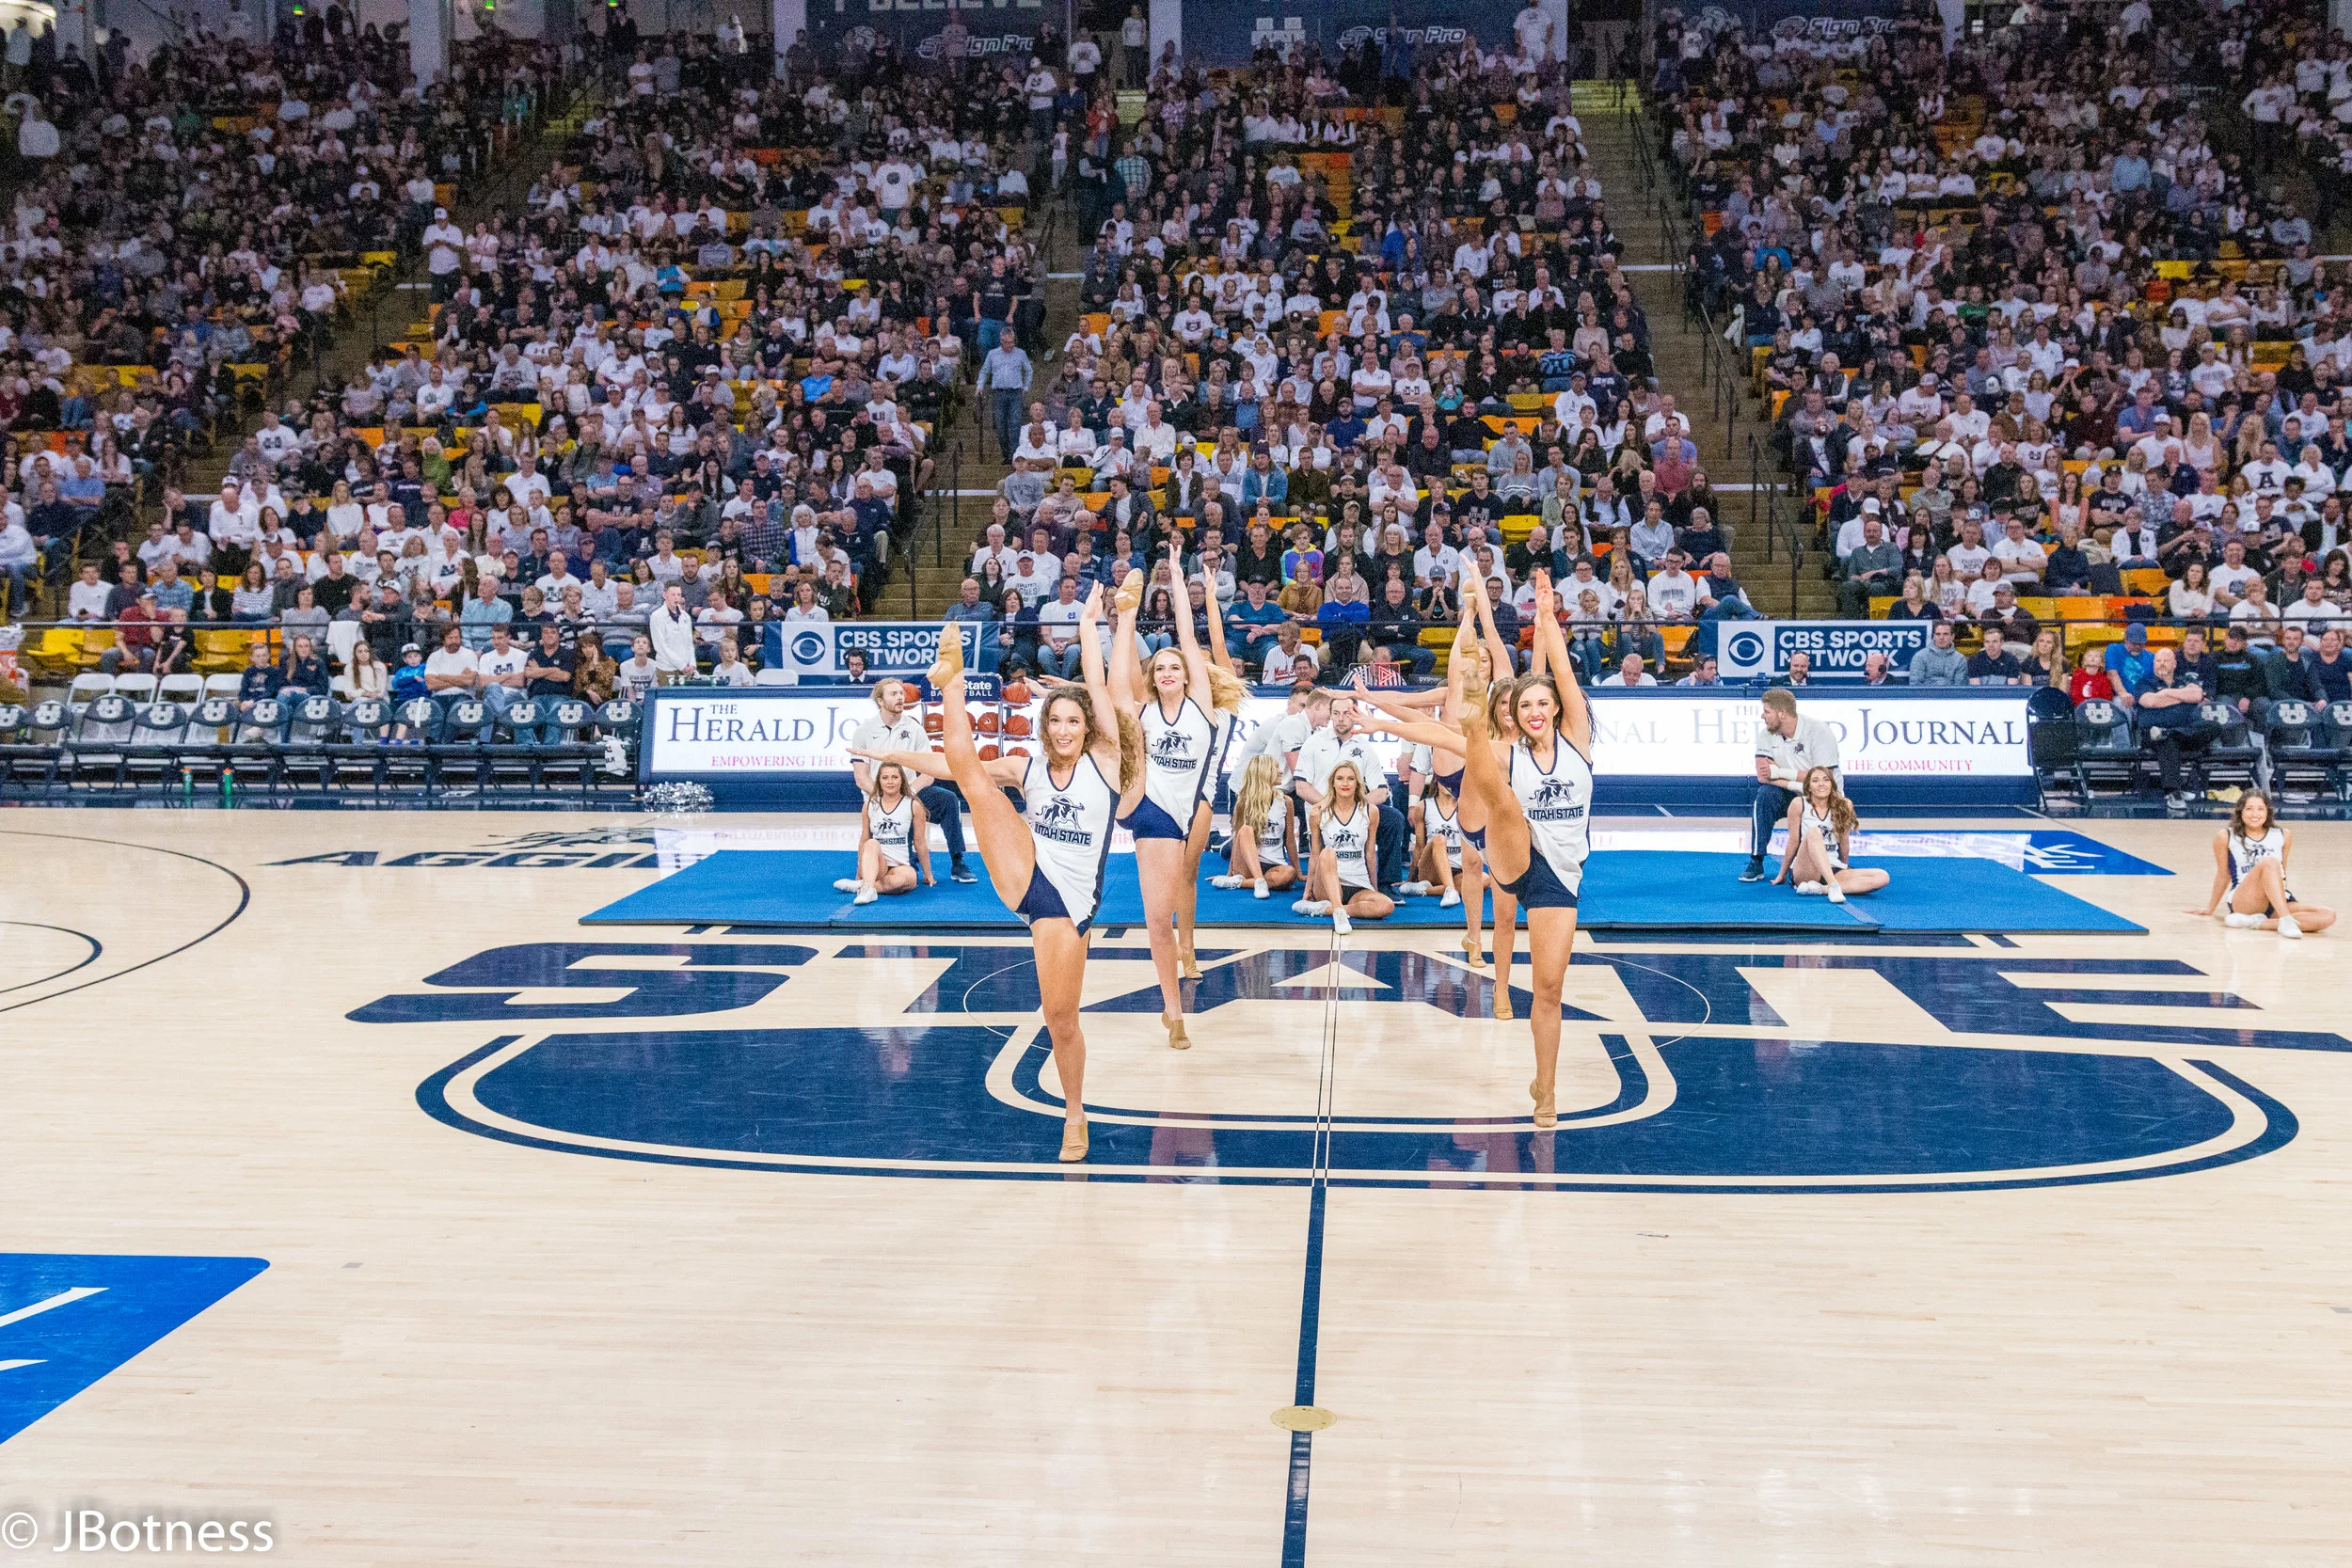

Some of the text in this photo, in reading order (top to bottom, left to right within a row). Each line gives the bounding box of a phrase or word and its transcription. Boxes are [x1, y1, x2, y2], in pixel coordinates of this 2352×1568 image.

[838, 630, 971, 648] CBS SPORS
[1779, 630, 1921, 648] CBS SPORTS
[709, 704, 738, 715] THE
[666, 707, 815, 742] HERALD
[1858, 708, 2025, 752] JOURNAL
[711, 755, 805, 767] EMPOWERING
[809, 755, 836, 767] THE
[1171, 758, 1198, 769] STATE
[1846, 759, 1973, 771] THE COMMUNITY
[1528, 804, 1584, 820] UTAH STATE
[1035, 823, 1091, 846] UTAH STATE
